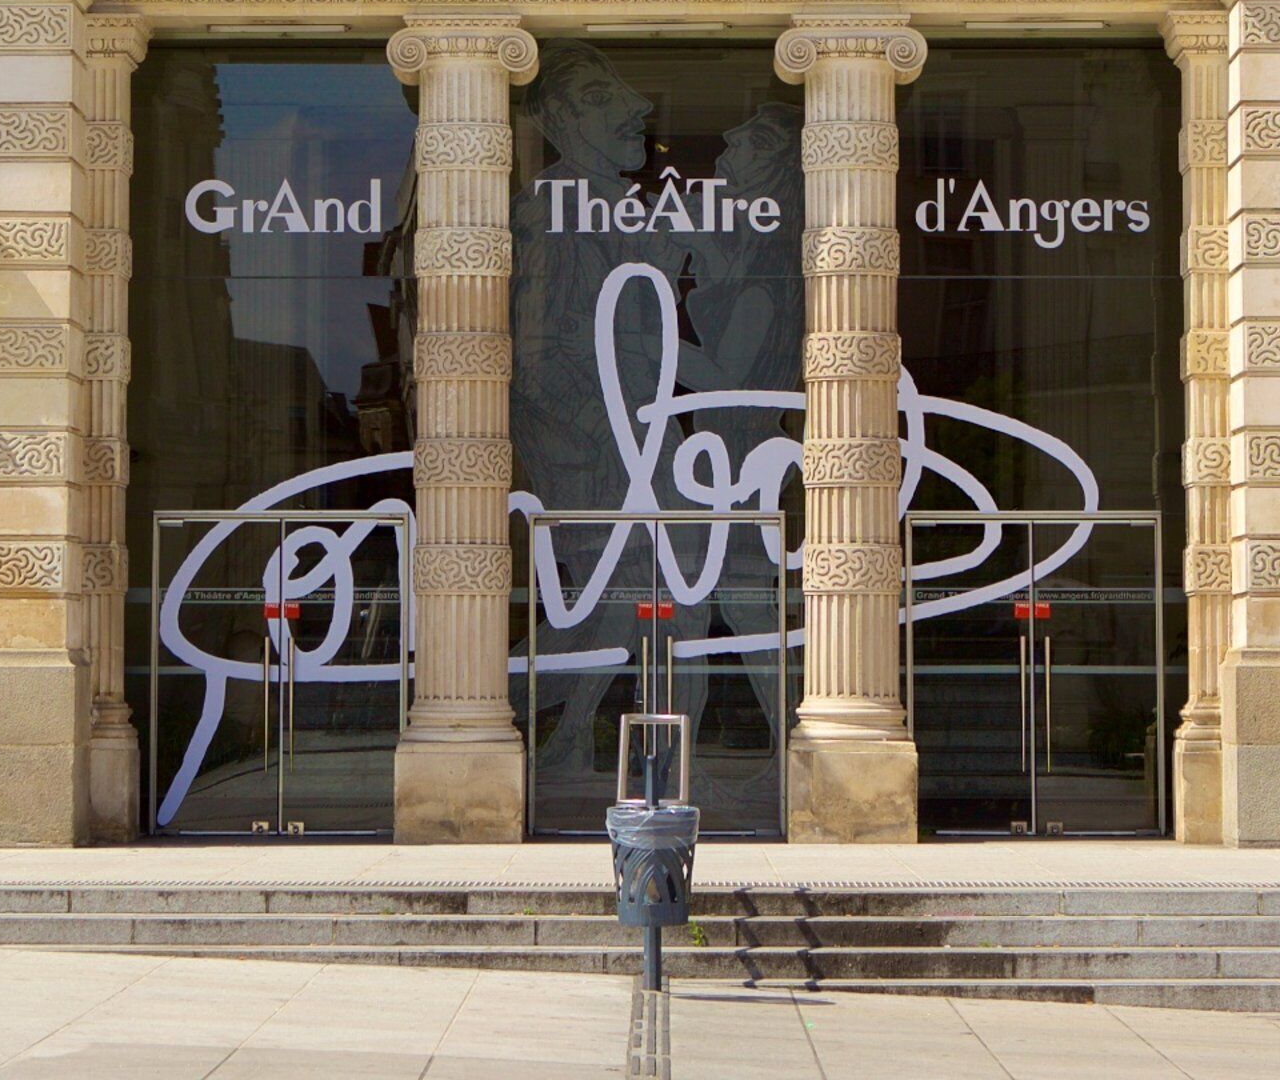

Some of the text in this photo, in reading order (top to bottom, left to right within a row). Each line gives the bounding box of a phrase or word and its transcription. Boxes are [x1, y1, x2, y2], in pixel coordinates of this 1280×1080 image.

[915, 178, 1151, 249] d'Angers
[194, 591, 232, 600] Théâtre
[234, 591, 266, 601] d'Ange
[916, 591, 945, 600] Grand
